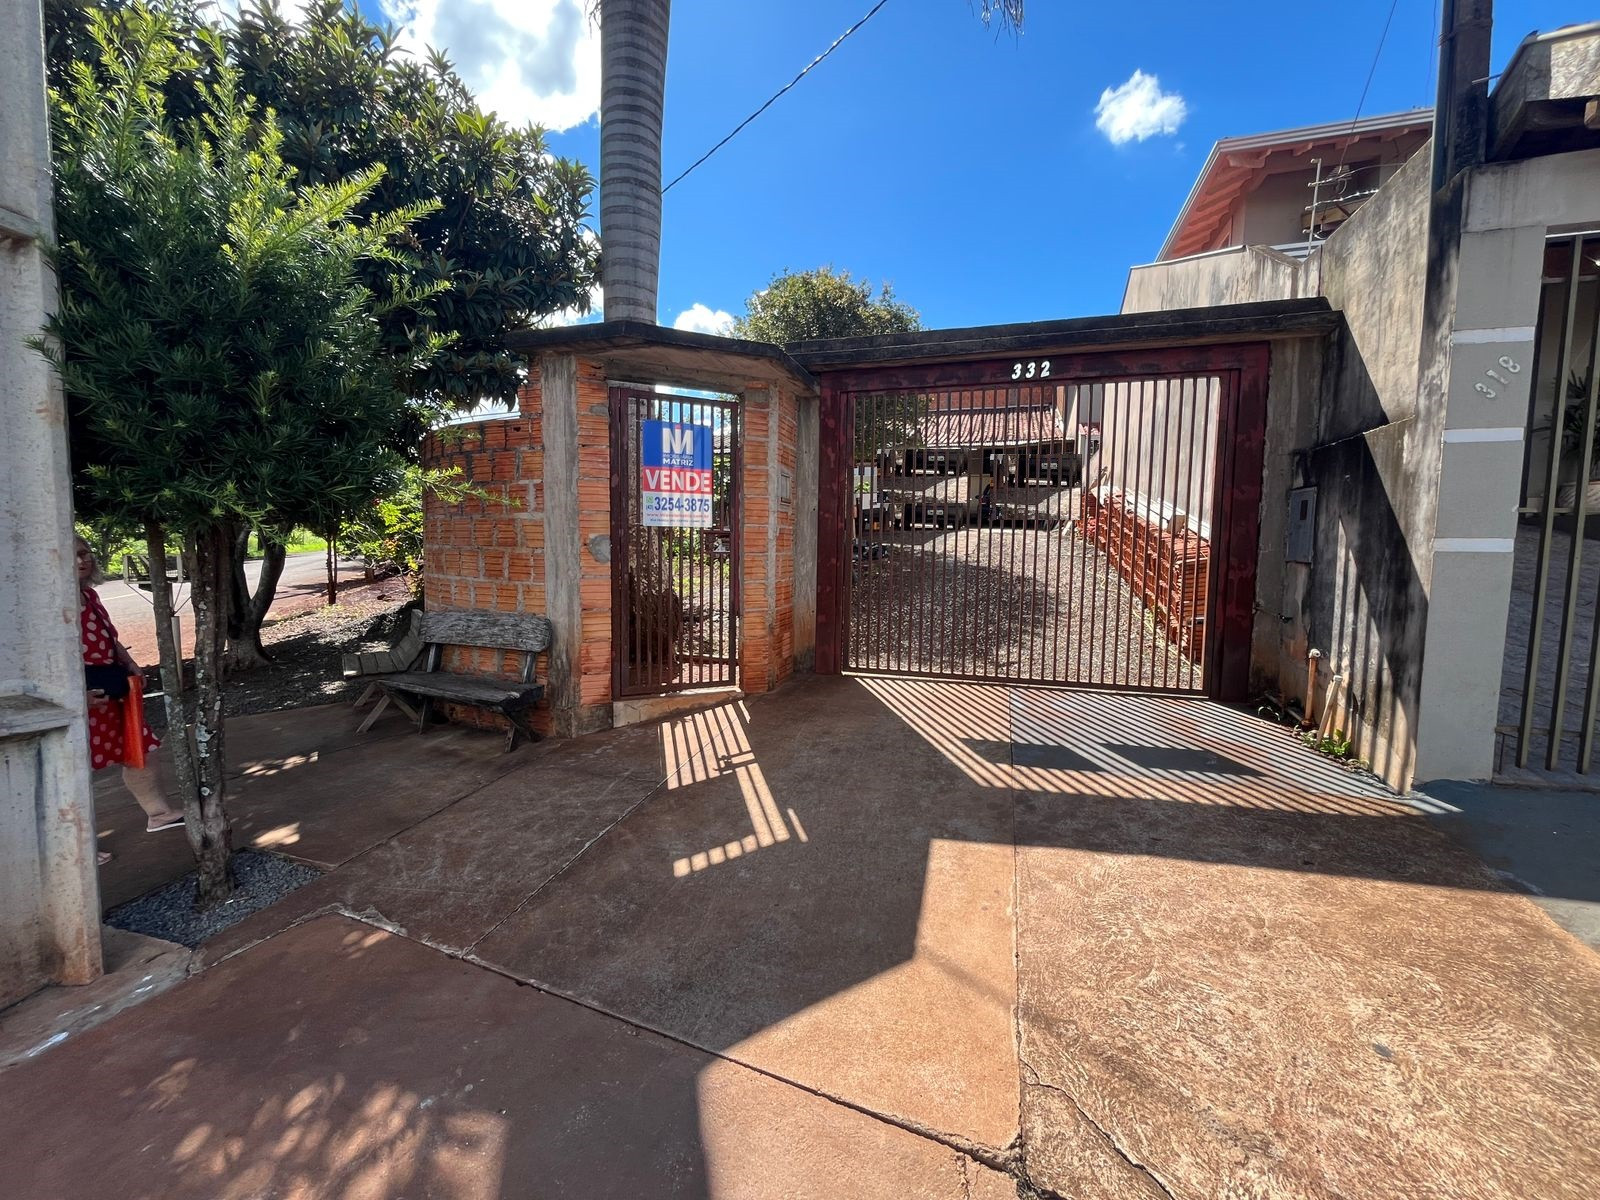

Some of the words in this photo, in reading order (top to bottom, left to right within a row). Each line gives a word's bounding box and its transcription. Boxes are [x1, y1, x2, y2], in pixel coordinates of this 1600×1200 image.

[1011, 360, 1051, 380] 332
[1474, 355, 1521, 398] 318
[662, 457, 694, 467] MATRIZ
[645, 469, 710, 492] VENDE
[654, 496, 710, 513] 3254-3875
